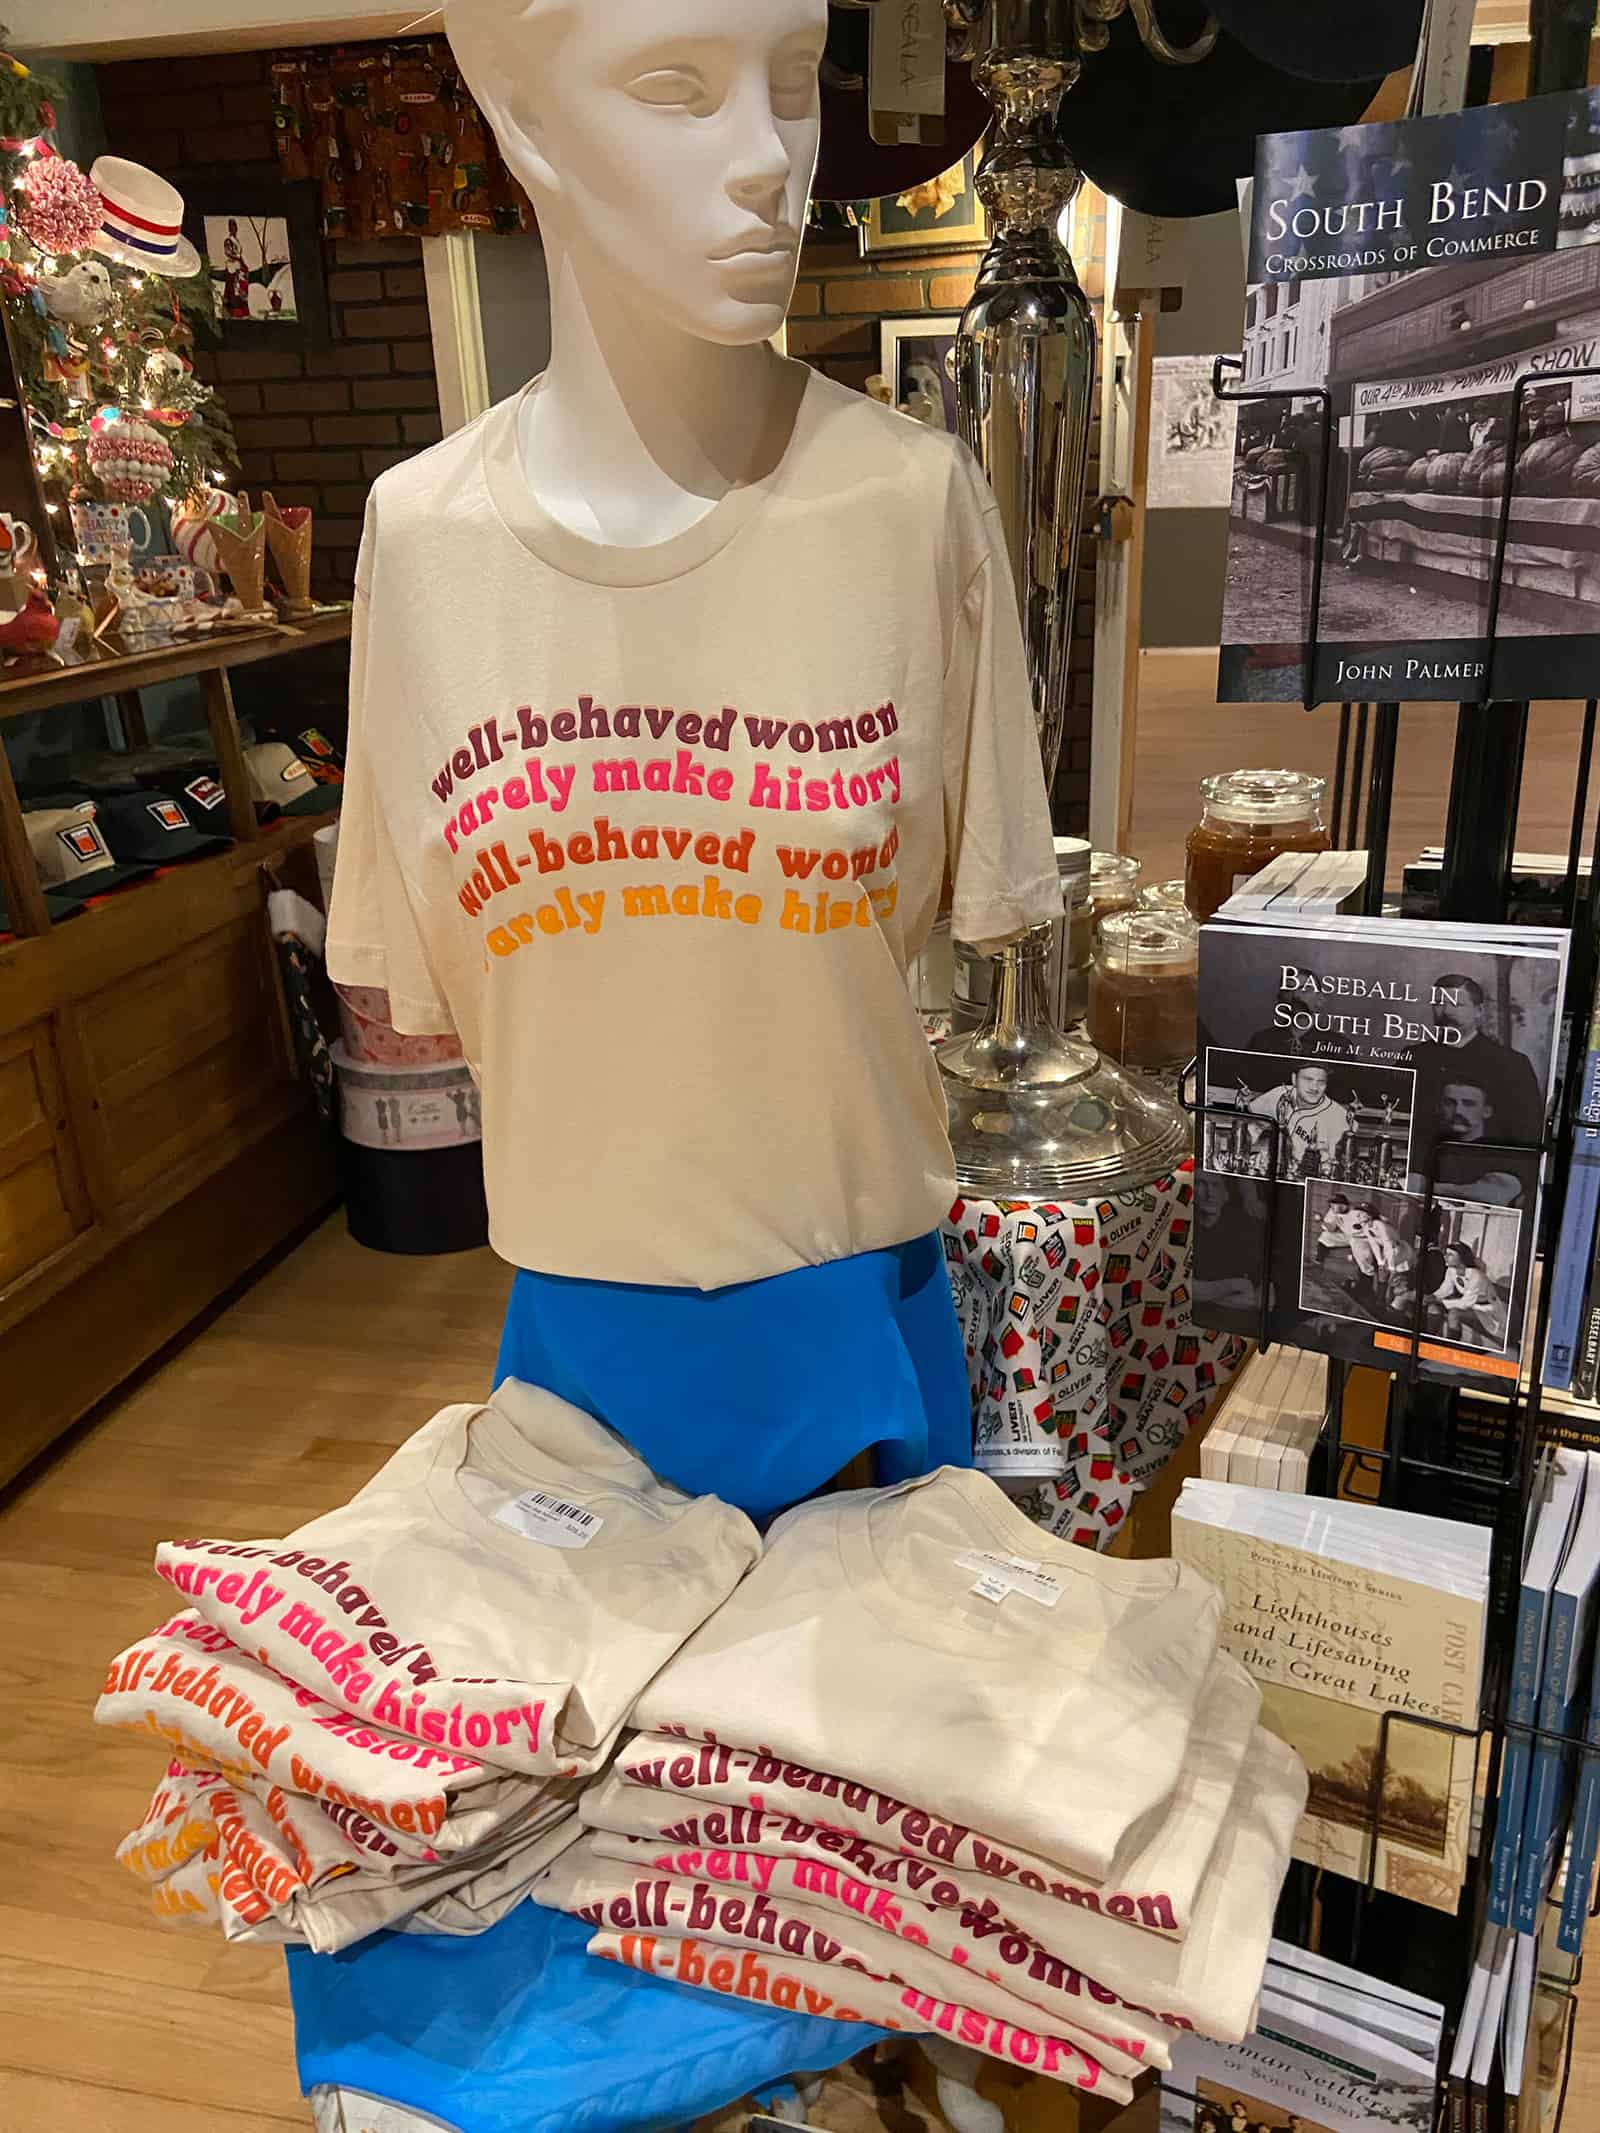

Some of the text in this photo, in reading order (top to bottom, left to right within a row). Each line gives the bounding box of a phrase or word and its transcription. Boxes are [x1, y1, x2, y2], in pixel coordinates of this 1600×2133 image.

[1266, 179, 1547, 241] SOUTH BEND
[1265, 229, 1539, 274] CROSSROADS OF COMMERCE
[1360, 388, 1378, 406] OUR
[1400, 381, 1444, 400] ANNUAL
[1451, 360, 1518, 391] PUMPKIN
[1530, 341, 1597, 371] SHOW
[1335, 659, 1484, 684] JOHN PALMER
[432, 696, 900, 803] well-behaved women
[443, 748, 901, 855] rarely make history
[456, 816, 756, 918] well-behaved
[482, 885, 606, 973] arely
[621, 874, 764, 926] make
[1279, 965, 1460, 1006] BASEBALL IN
[1273, 1003, 1462, 1045] SOUTH BEND
[1311, 1040, 1341, 1054] John
[1346, 1044, 1363, 1056] M.
[1110, 1216, 1142, 1241] OLIVER
[1058, 1373, 1092, 1399] OLIVER
[1251, 1594, 1393, 1648] Lighthouses
[1442, 1619, 1467, 1674] POST
[278, 1600, 374, 1705] make
[372, 1680, 545, 1754] history
[1233, 1619, 1411, 1684] and Lifesaving
[1242, 1648, 1441, 1717] the Great Lakes
[1303, 2069, 1394, 2115] Settlers
